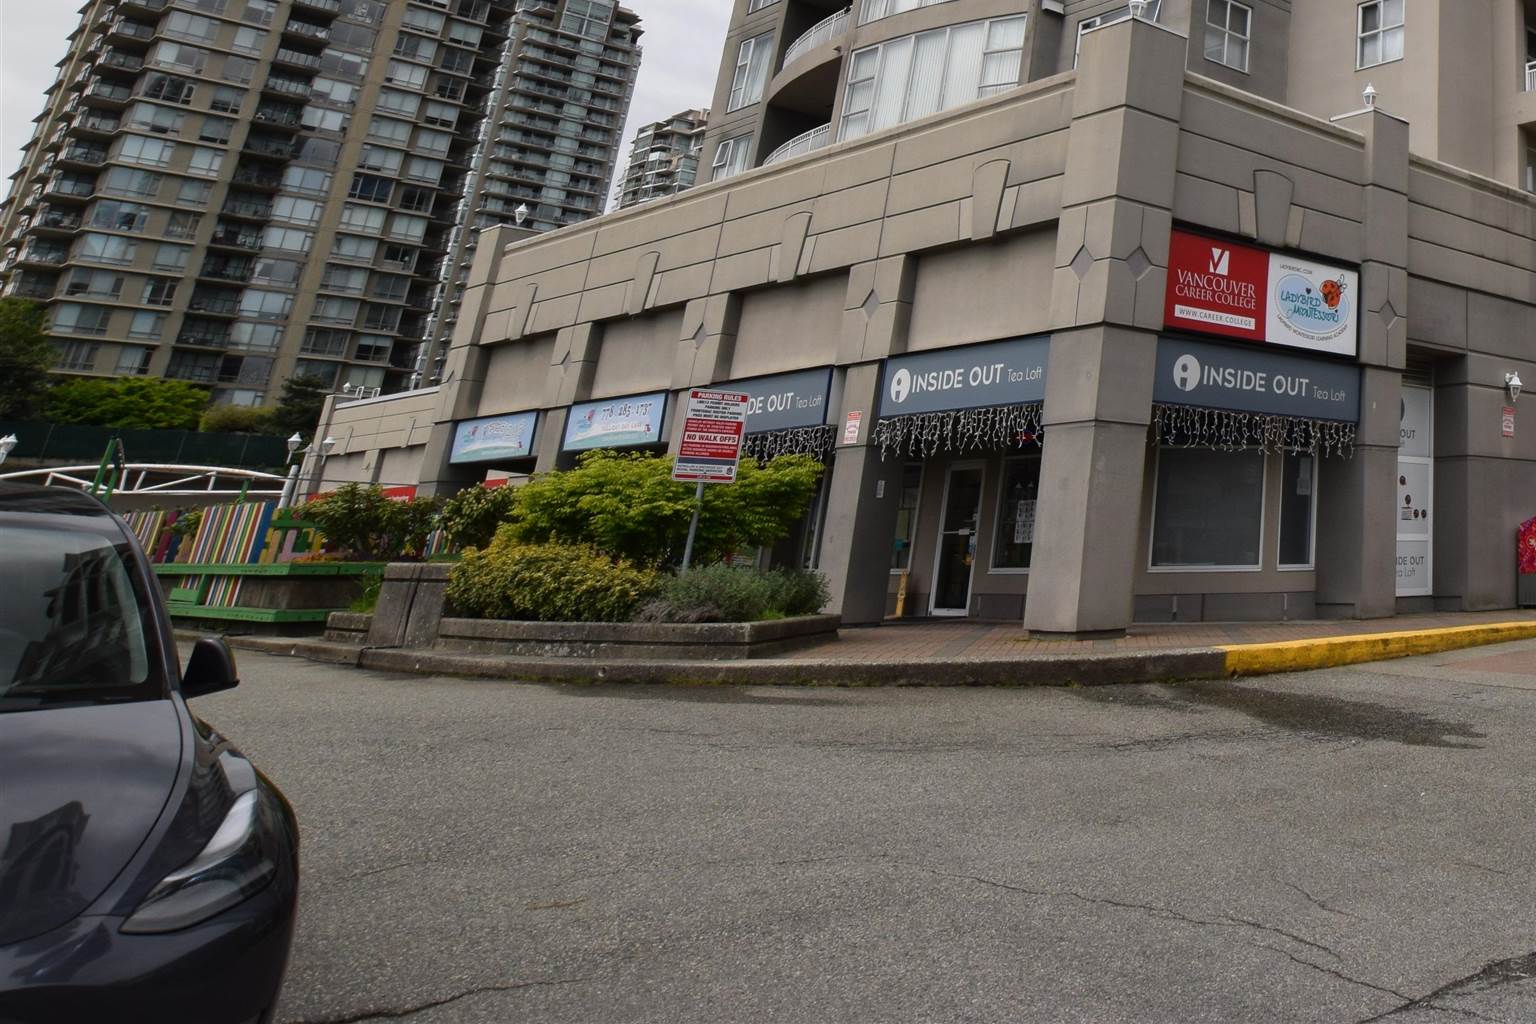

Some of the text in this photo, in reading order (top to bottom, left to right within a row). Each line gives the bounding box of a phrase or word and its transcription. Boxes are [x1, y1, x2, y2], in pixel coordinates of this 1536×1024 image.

[1177, 269, 1256, 298] VANCOUVER
[1175, 284, 1256, 310] CAREER COLLEGE
[911, 369, 964, 393] INSIDE
[969, 364, 1004, 387] OUT
[1007, 369, 1023, 382] Tea
[1025, 366, 1042, 380] Loft
[1203, 365, 1266, 392] INSIDE
[1272, 375, 1309, 397] OUT
[1313, 386, 1329, 400] Tea
[1330, 388, 1345, 402] Loft
[697, 392, 722, 400] PARKING
[768, 392, 794, 412] OUT
[795, 396, 808, 409] Tea
[809, 394, 822, 408] Loft
[1399, 428, 1416, 439] OUT
[1409, 556, 1424, 566] OUT
